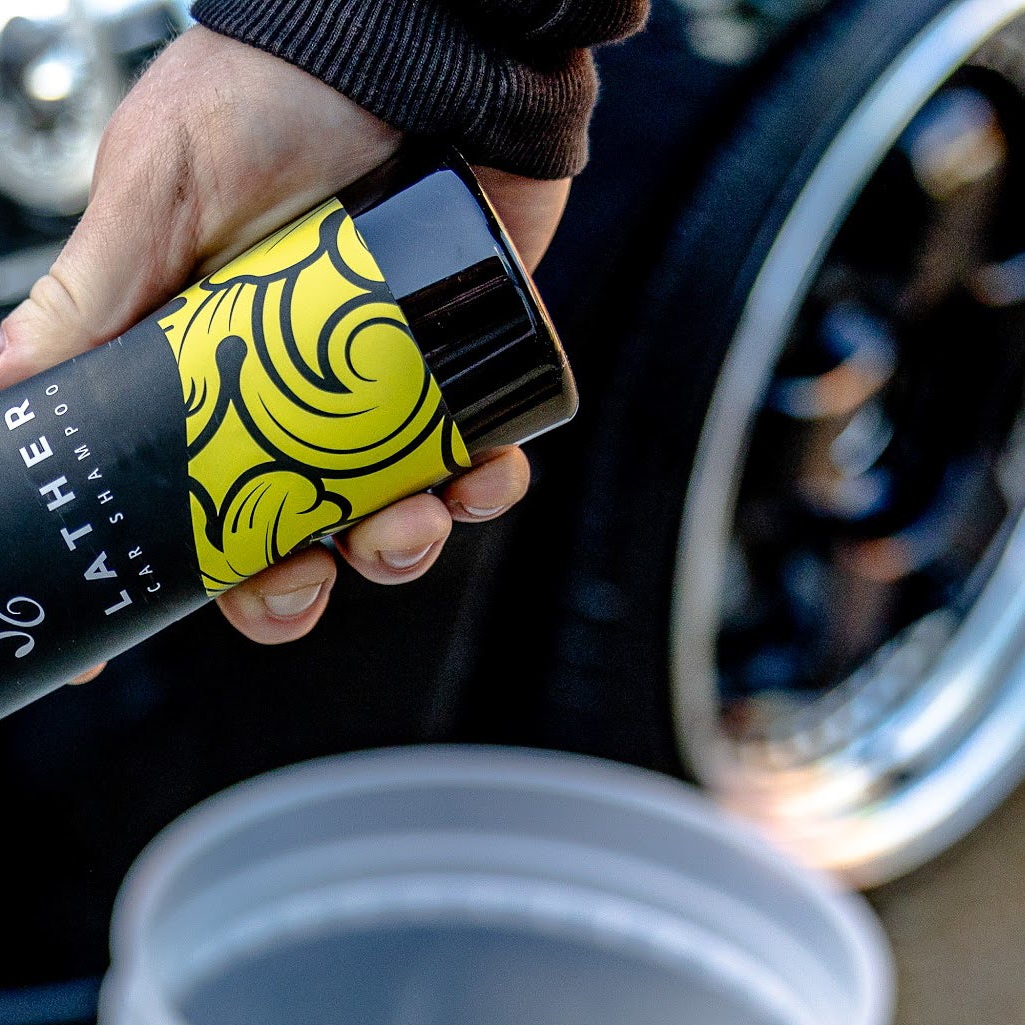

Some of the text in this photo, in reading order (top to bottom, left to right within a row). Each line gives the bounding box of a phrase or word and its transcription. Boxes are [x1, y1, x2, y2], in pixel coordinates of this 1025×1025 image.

[3, 397, 133, 616] LATHER
[45, 383, 162, 594] CAR SHAMPOO
